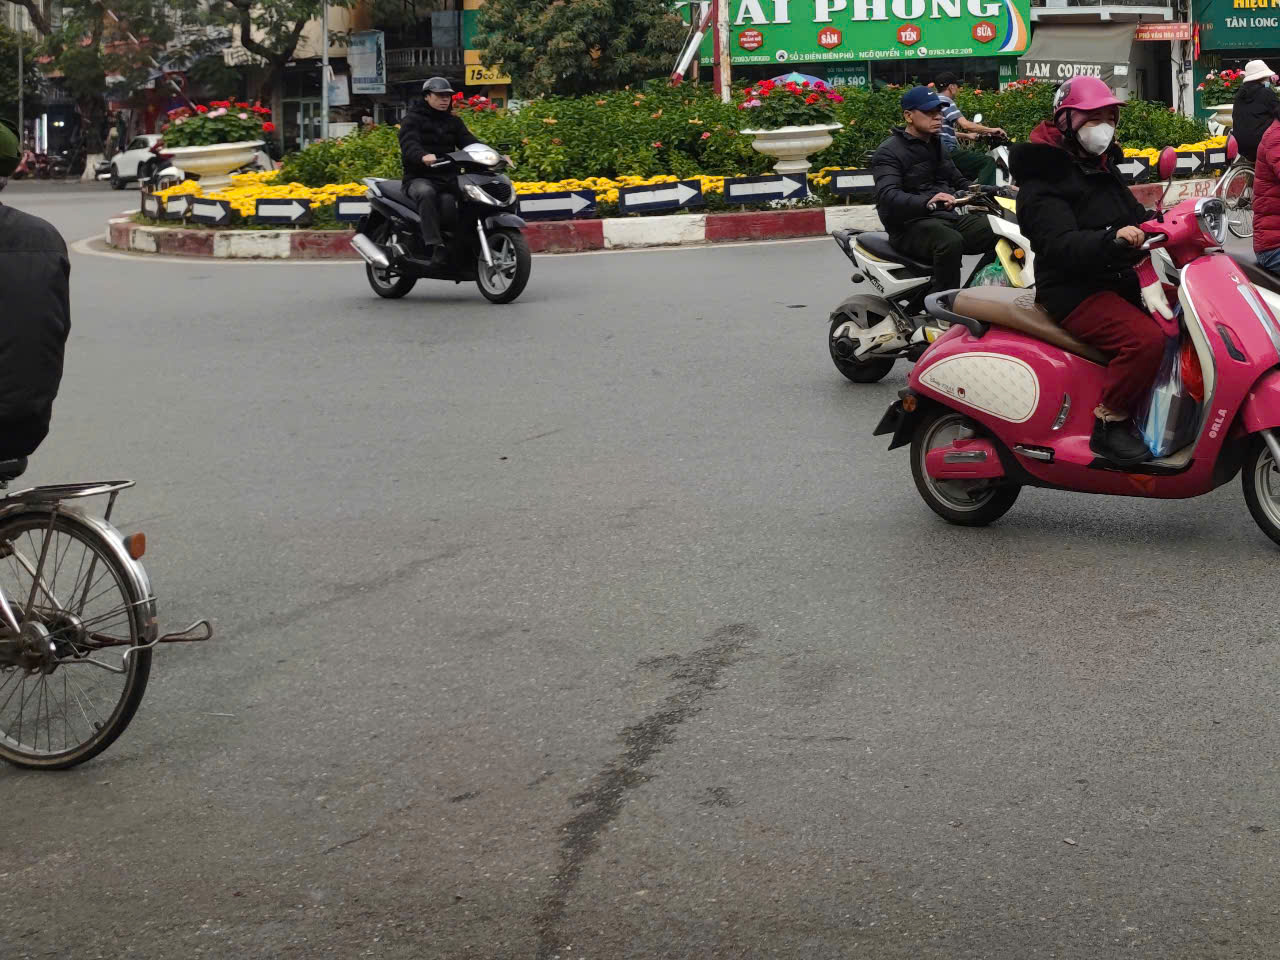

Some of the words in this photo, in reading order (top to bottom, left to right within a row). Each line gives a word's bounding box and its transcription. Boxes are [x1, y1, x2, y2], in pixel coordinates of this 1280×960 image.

[1225, 15, 1248, 28] TÂN
[1250, 17, 1278, 28] LONG
[900, 27, 917, 41] YẾN
[977, 24, 993, 37] SỮA
[820, 31, 838, 44] SÂM
[904, 49, 914, 57] HP
[1026, 62, 1050, 77] LAM
[1057, 63, 1102, 79] COFFEE
[828, 73, 845, 86] YẾN
[1209, 409, 1228, 439] ORLA
